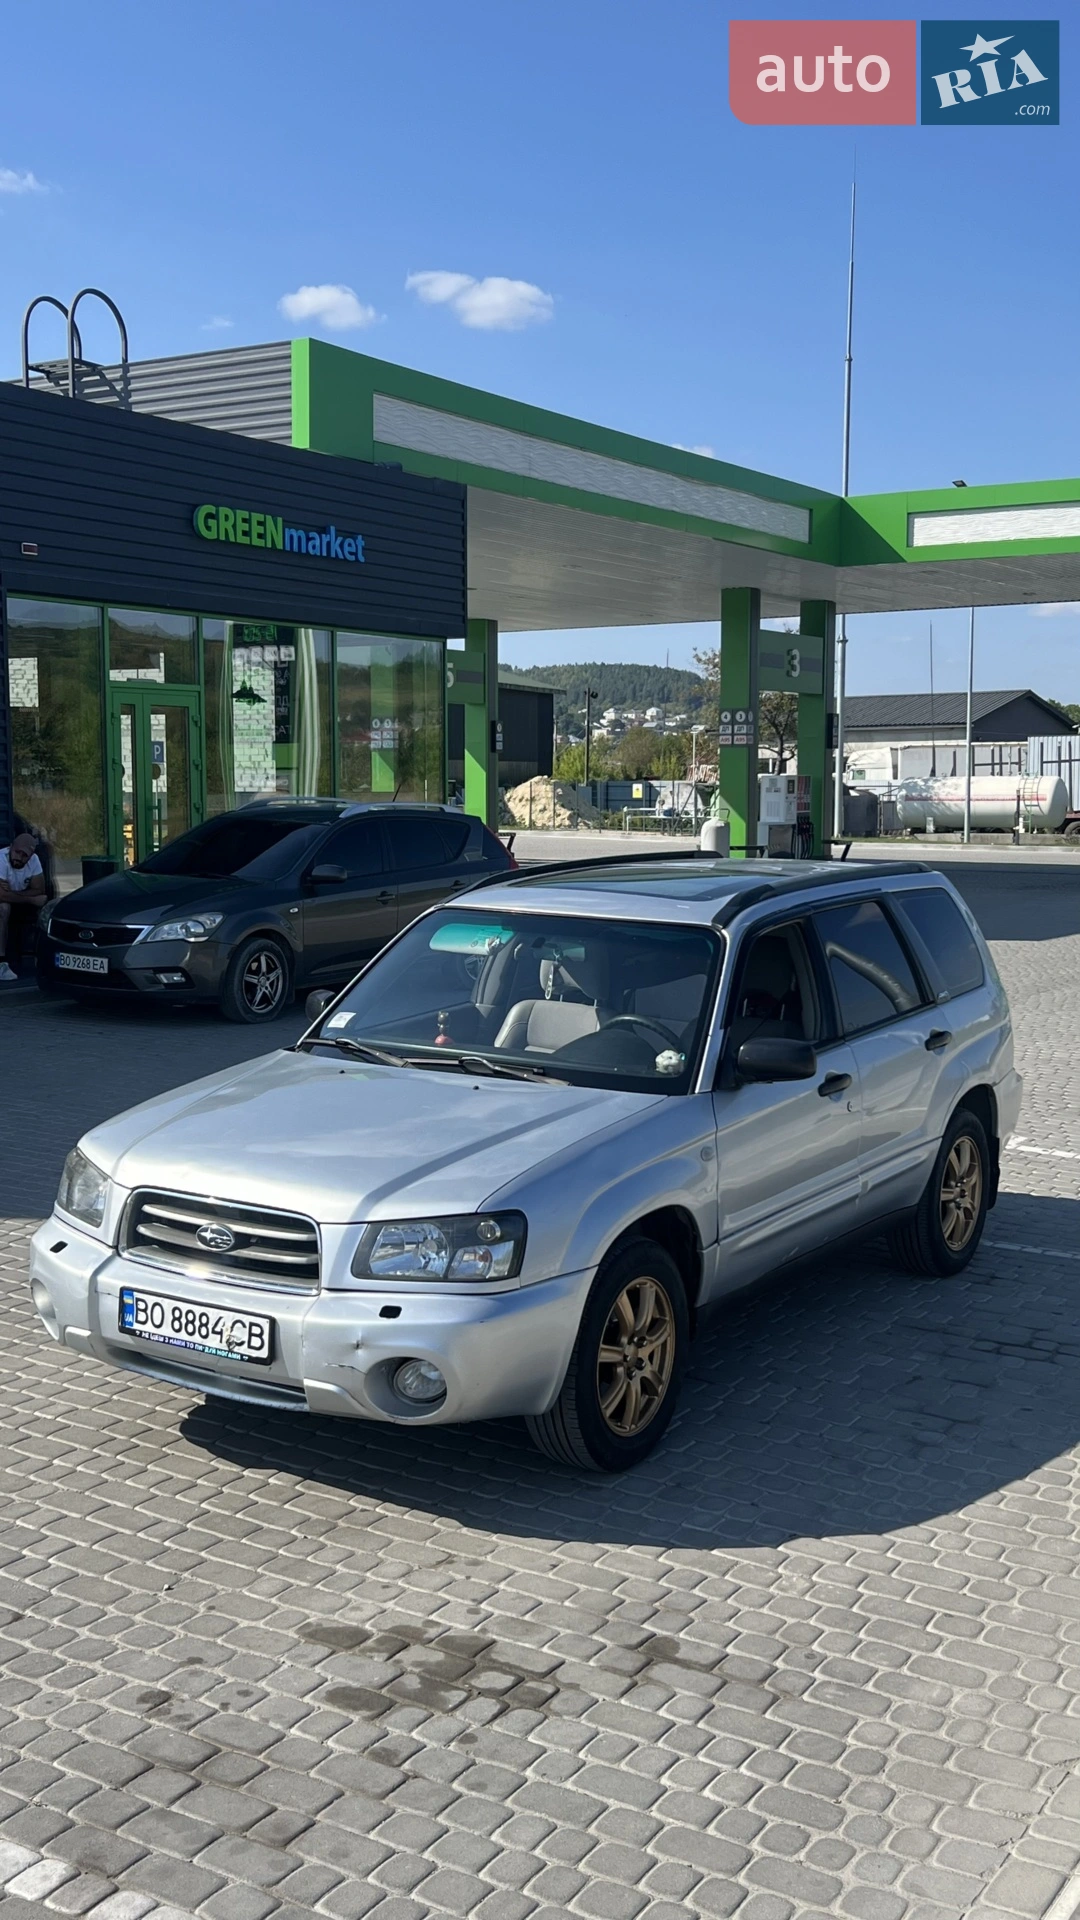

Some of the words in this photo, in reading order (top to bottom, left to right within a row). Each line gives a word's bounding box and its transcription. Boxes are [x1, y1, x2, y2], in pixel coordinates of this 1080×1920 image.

[786, 649, 800, 678] 3
[154, 745, 161, 759] P
[60, 954, 71, 967] BO
[72, 957, 91, 969] 9268
[93, 959, 105, 971] EA
[135, 1297, 165, 1329] BO
[171, 1305, 225, 1344] 8884
[229, 1319, 265, 1351] CB
